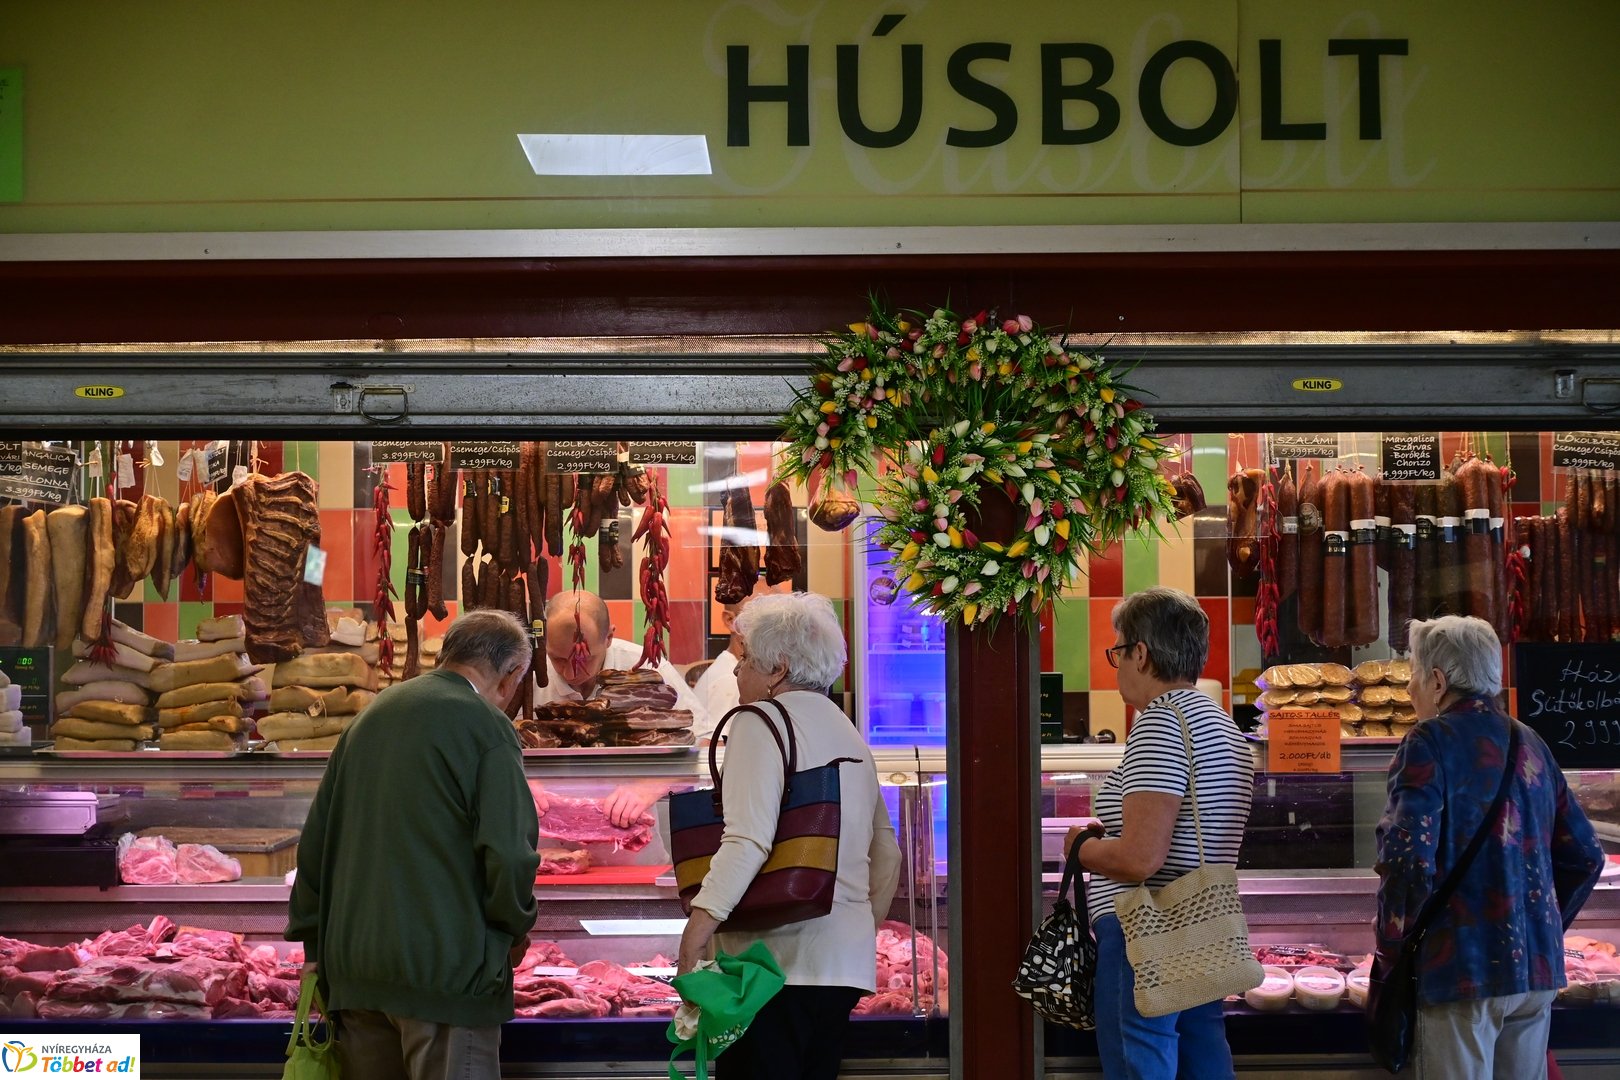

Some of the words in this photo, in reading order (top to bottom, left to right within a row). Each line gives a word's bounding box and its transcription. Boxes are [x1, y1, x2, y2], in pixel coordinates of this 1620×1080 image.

[726, 14, 1409, 149] HÚSBOLT
[1302, 380, 1332, 390] KLING
[84, 387, 114, 397] KLING
[1277, 434, 1334, 445] SZALÁMI
[22, 462, 70, 476] SEMEGE
[1279, 751, 1331, 760] 2.000Ft/db
